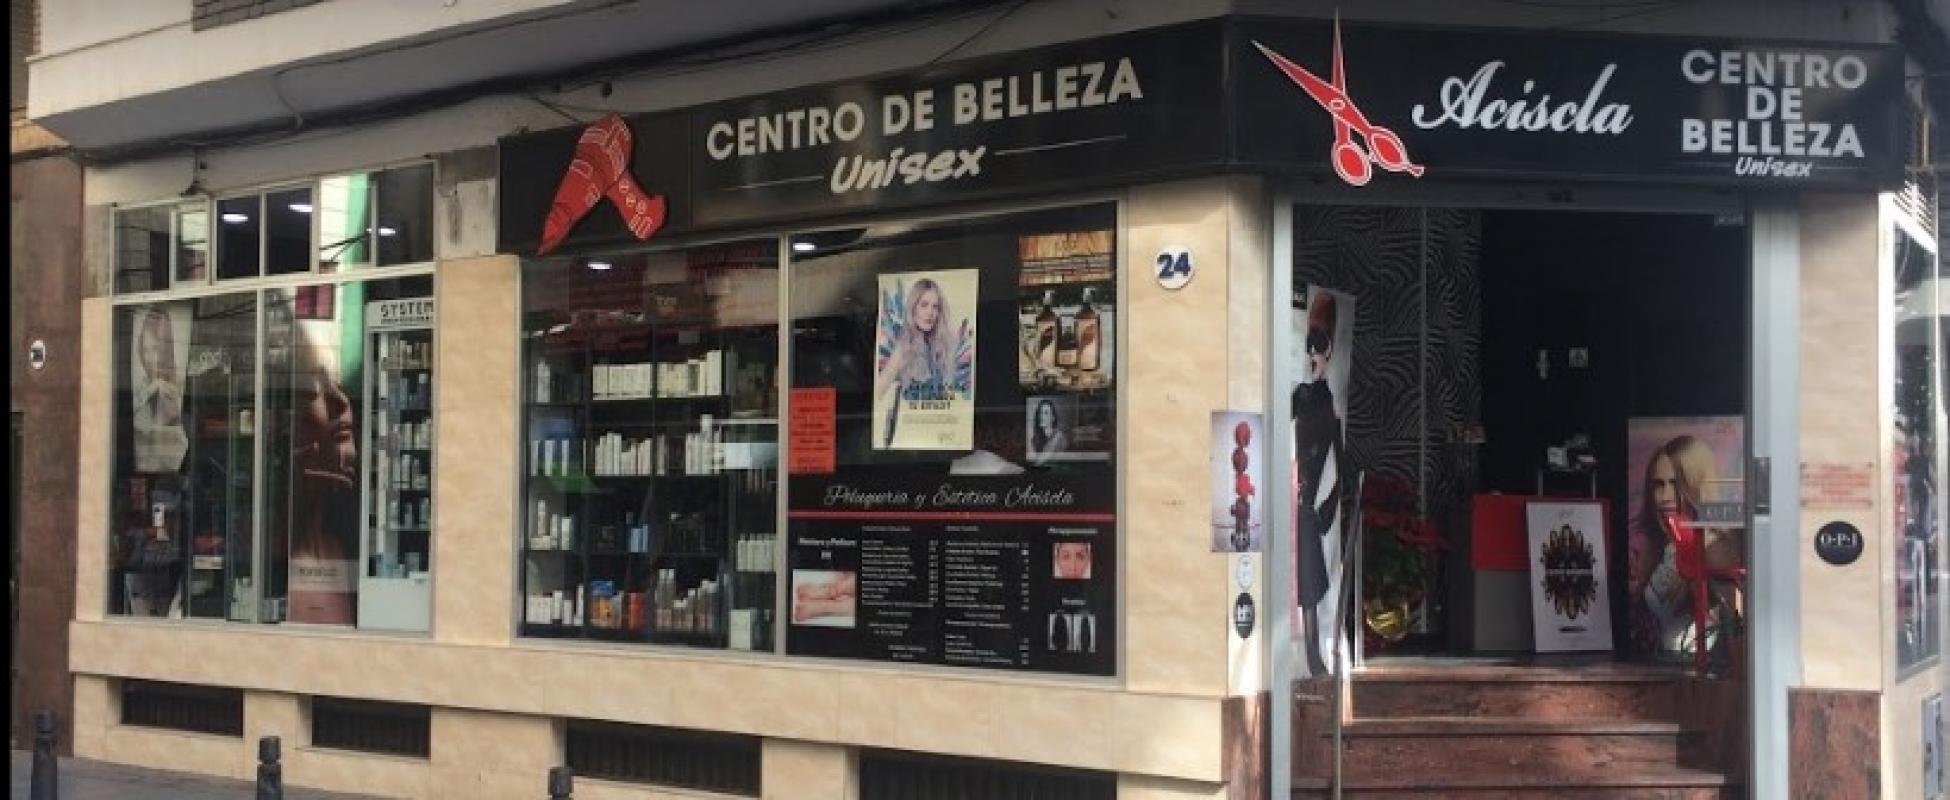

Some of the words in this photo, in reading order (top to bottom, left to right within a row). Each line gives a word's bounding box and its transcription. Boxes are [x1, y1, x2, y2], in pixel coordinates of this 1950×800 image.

[1681, 49, 1868, 89] CENTRO
[706, 101, 865, 161] CENTRO
[882, 88, 934, 137] DE
[952, 56, 1144, 126] BELLEZA
[1411, 59, 1635, 134] Aciscla
[1747, 86, 1803, 120] DE
[1682, 118, 1865, 158] BELLEZA
[830, 145, 987, 194] Unisex
[1735, 156, 1813, 177] Unisex
[1156, 251, 1192, 279] 24
